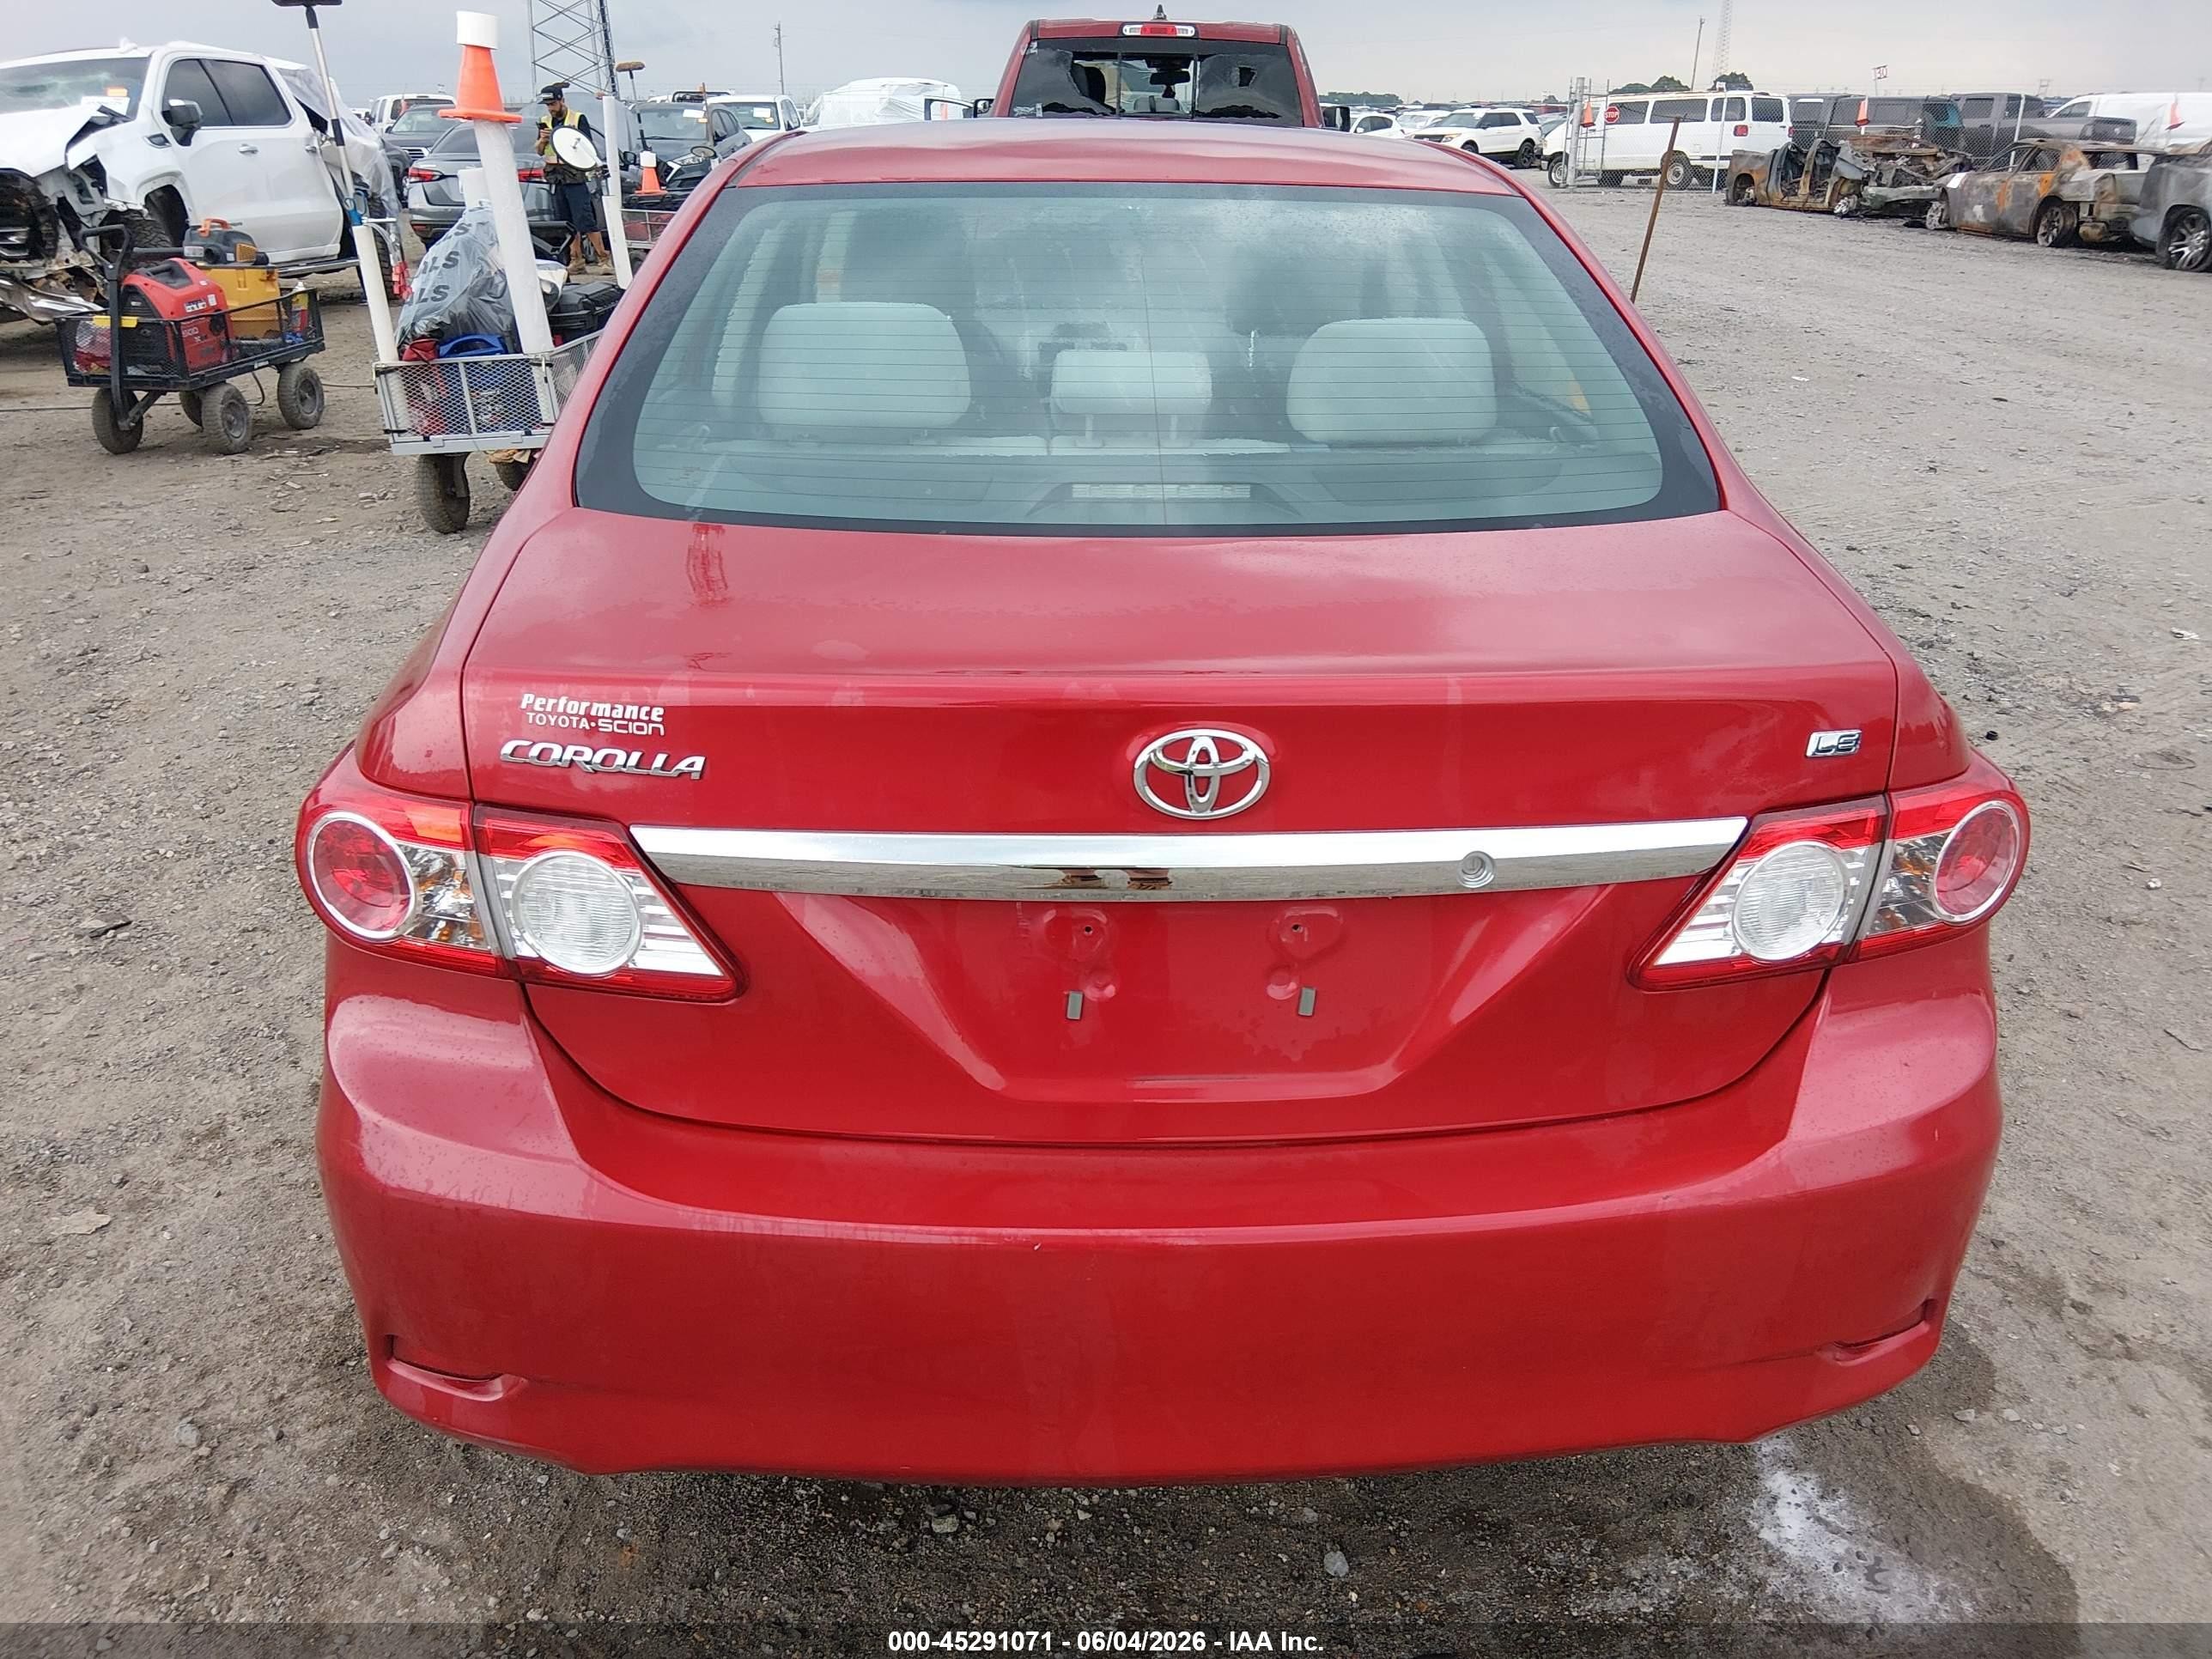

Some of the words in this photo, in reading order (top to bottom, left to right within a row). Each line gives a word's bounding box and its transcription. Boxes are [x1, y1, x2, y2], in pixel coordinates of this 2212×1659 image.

[520, 693, 665, 720] Performance
[1808, 731, 1862, 757] LE
[501, 739, 707, 781] COROLLA
